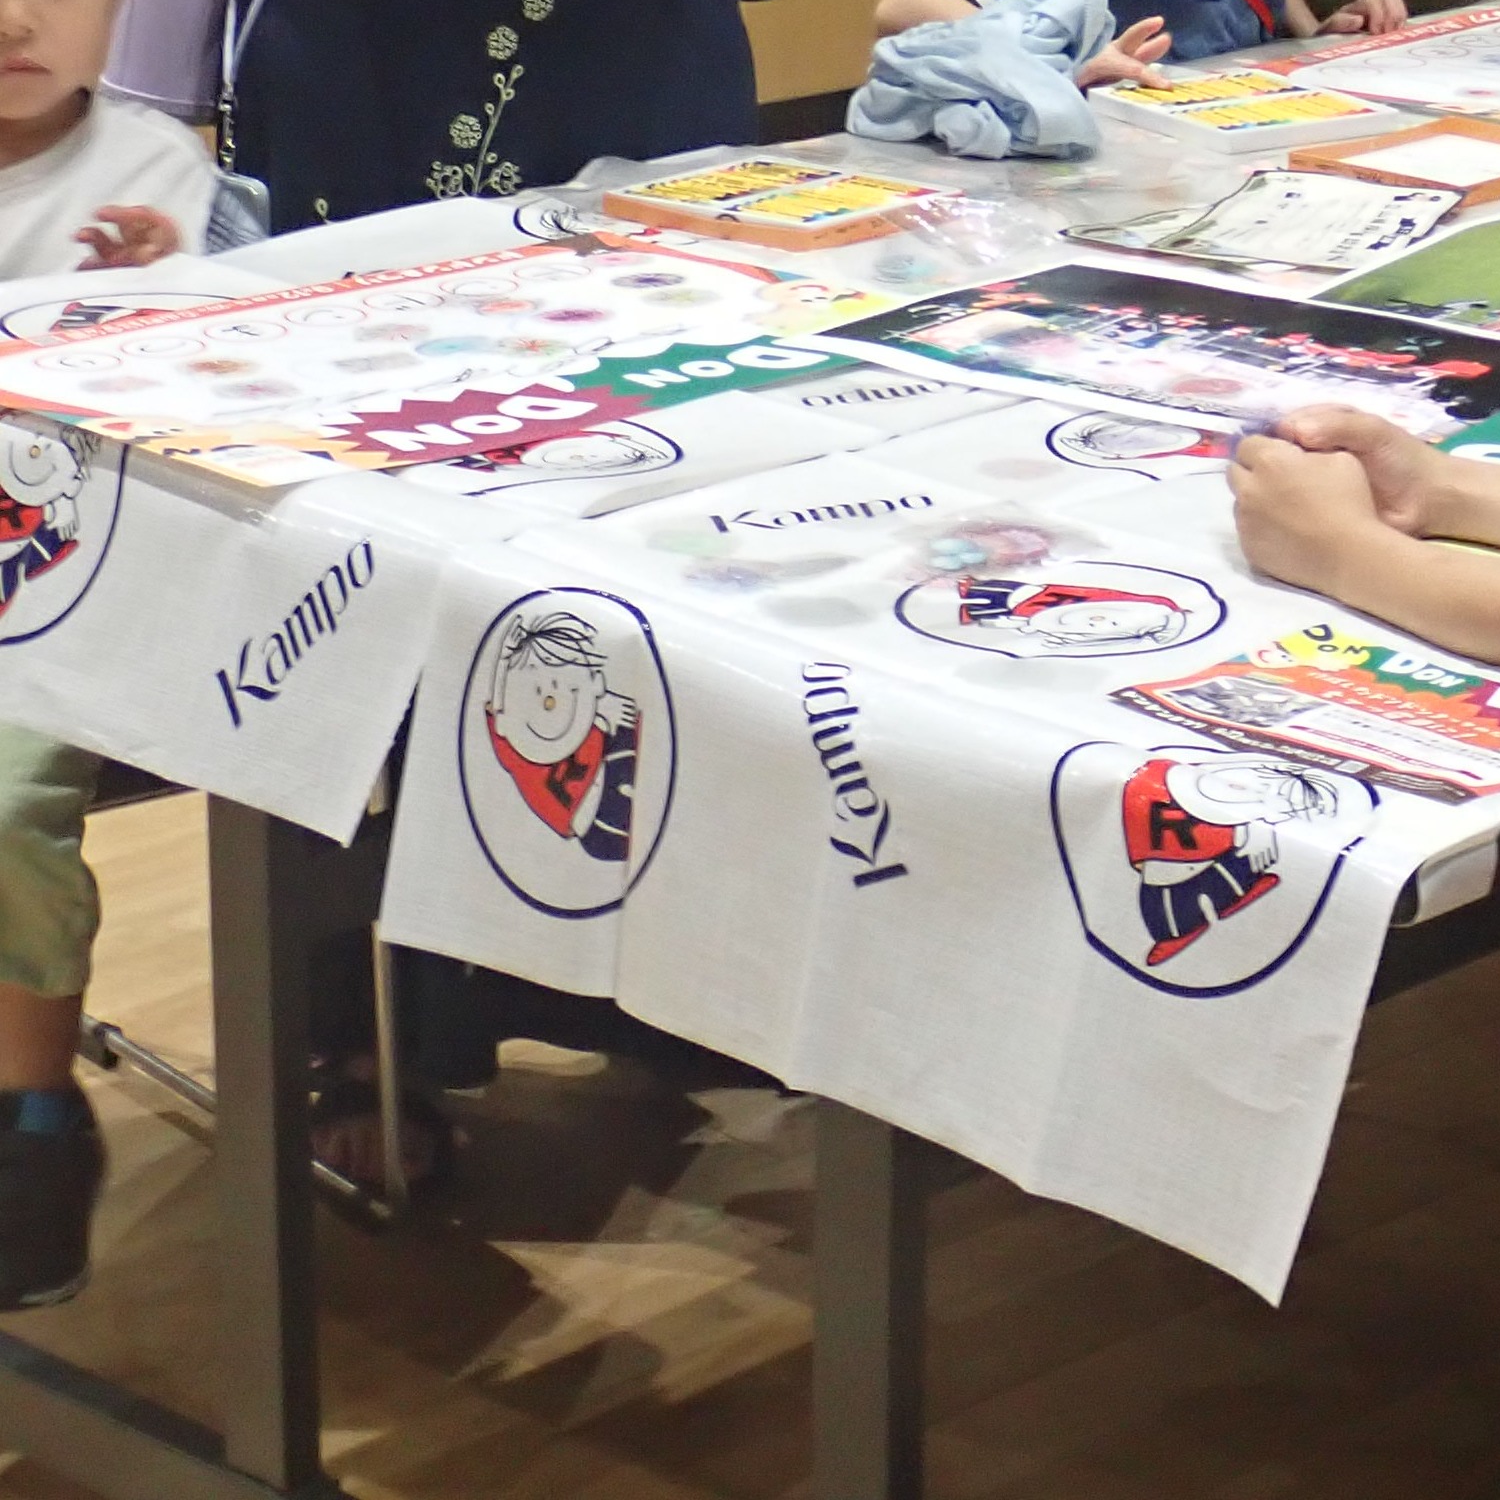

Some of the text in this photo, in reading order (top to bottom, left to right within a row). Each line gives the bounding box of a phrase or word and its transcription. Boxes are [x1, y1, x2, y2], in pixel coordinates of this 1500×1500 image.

[366, 394, 598, 452] DON
[709, 494, 933, 533] Kampo
[216, 539, 375, 729] Kampo
[1378, 650, 1466, 689] DON
[802, 662, 909, 889] Kampo
[1149, 805, 1198, 858] R
